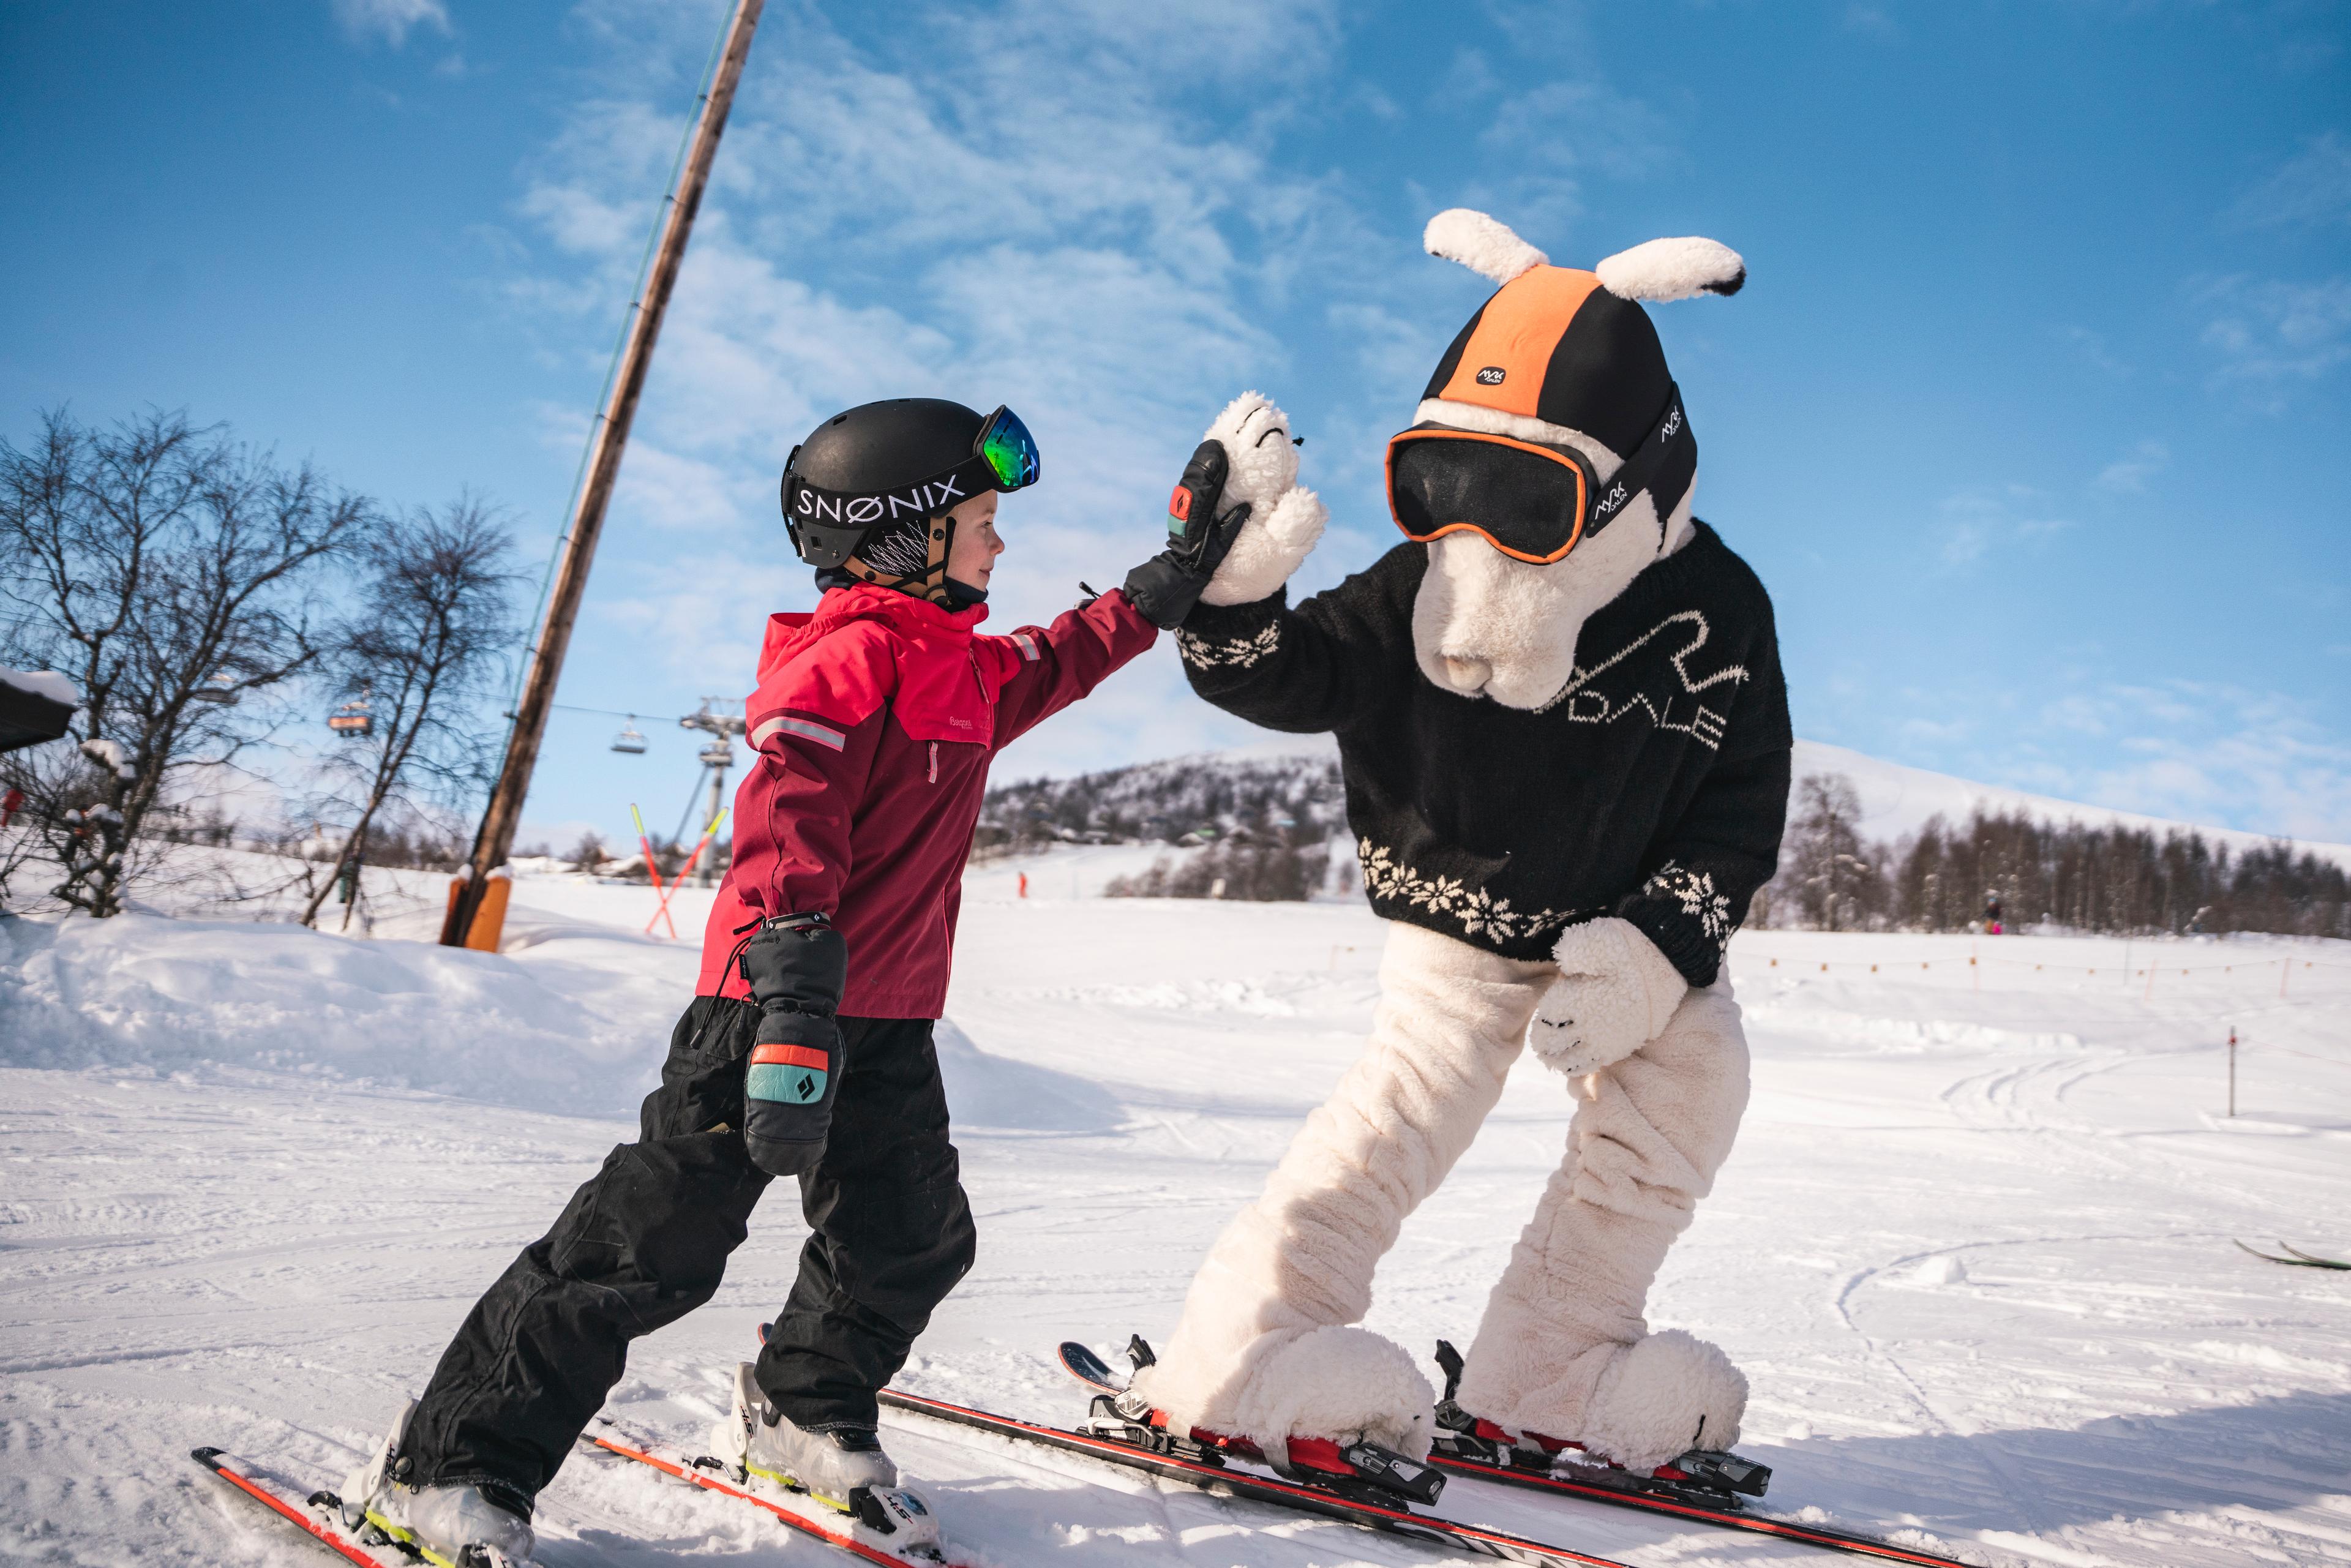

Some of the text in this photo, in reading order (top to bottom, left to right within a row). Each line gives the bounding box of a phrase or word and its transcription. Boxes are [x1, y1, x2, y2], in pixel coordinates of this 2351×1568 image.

[1478, 369, 1504, 380] MYRK
[1662, 405, 1679, 443] MYRK
[797, 474, 966, 523] SNØNIX
[1594, 481, 1625, 520] MYRK
[1611, 492, 1627, 511] DALEN
[1569, 692, 1727, 751] DALE
